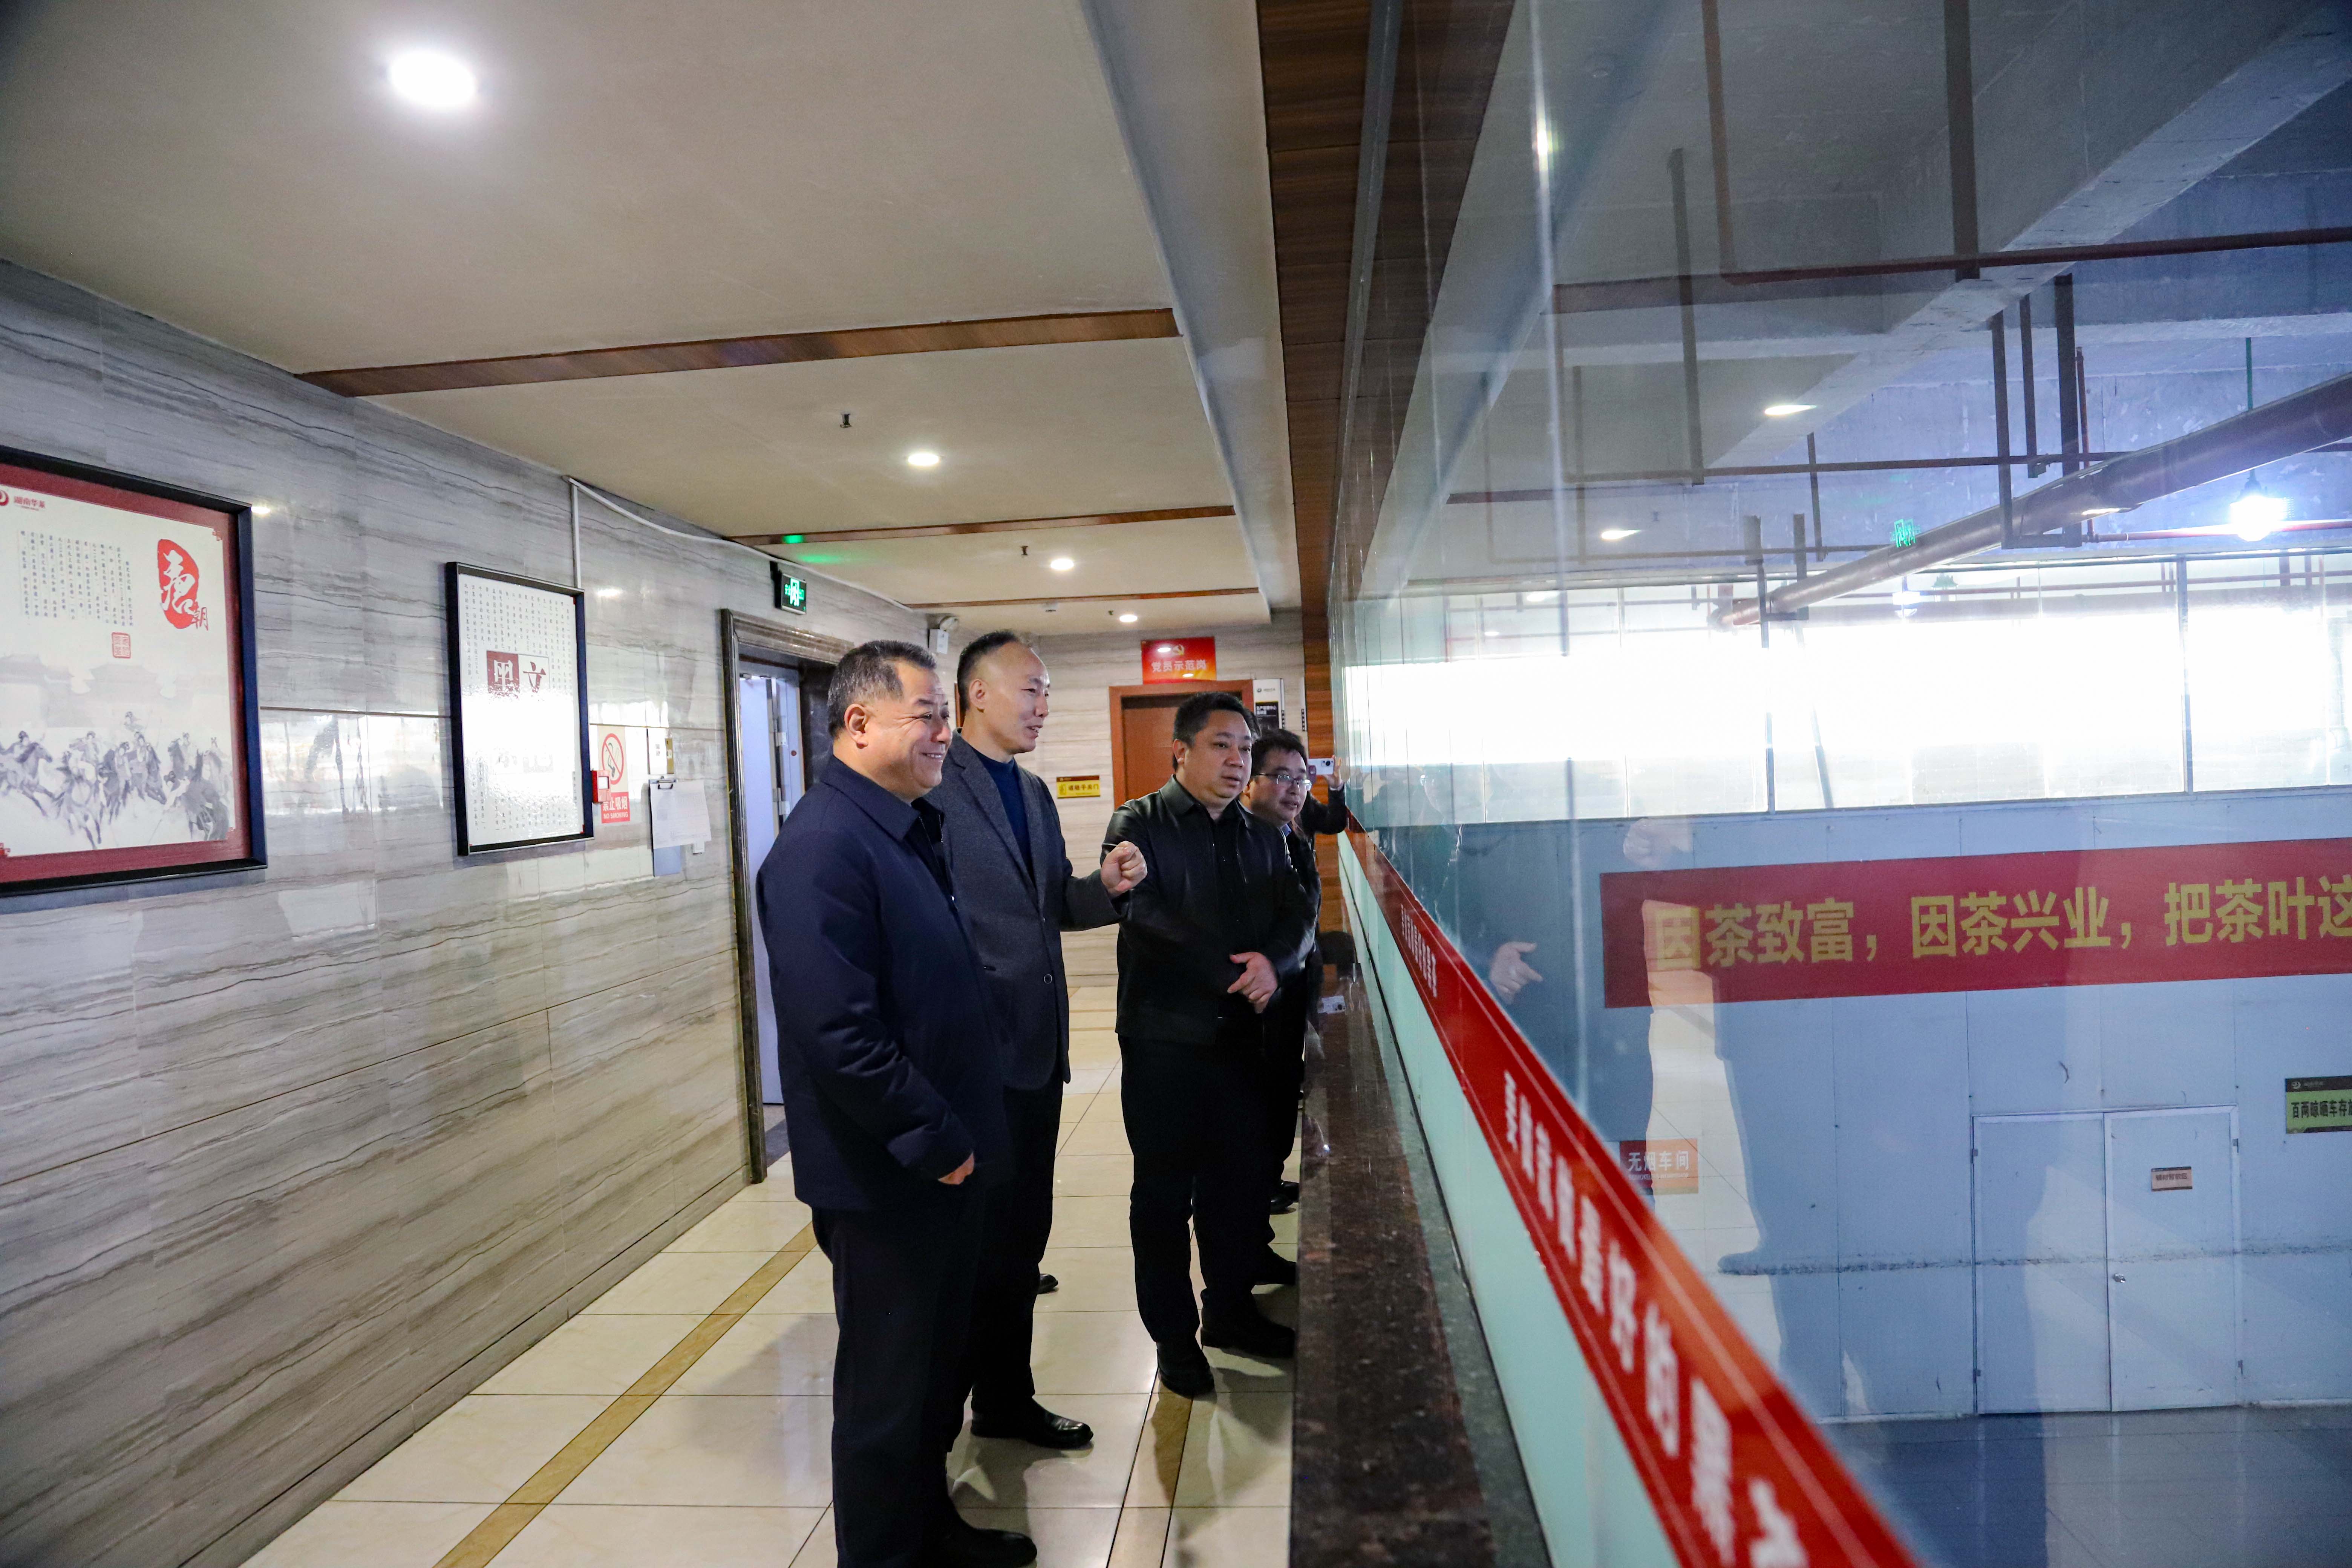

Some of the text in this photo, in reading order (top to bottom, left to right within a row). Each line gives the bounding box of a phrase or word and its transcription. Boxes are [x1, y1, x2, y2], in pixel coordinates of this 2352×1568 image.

[1152, 660, 1207, 672] 党员示范岗
[1628, 1151, 1689, 1172] 无烟车间
